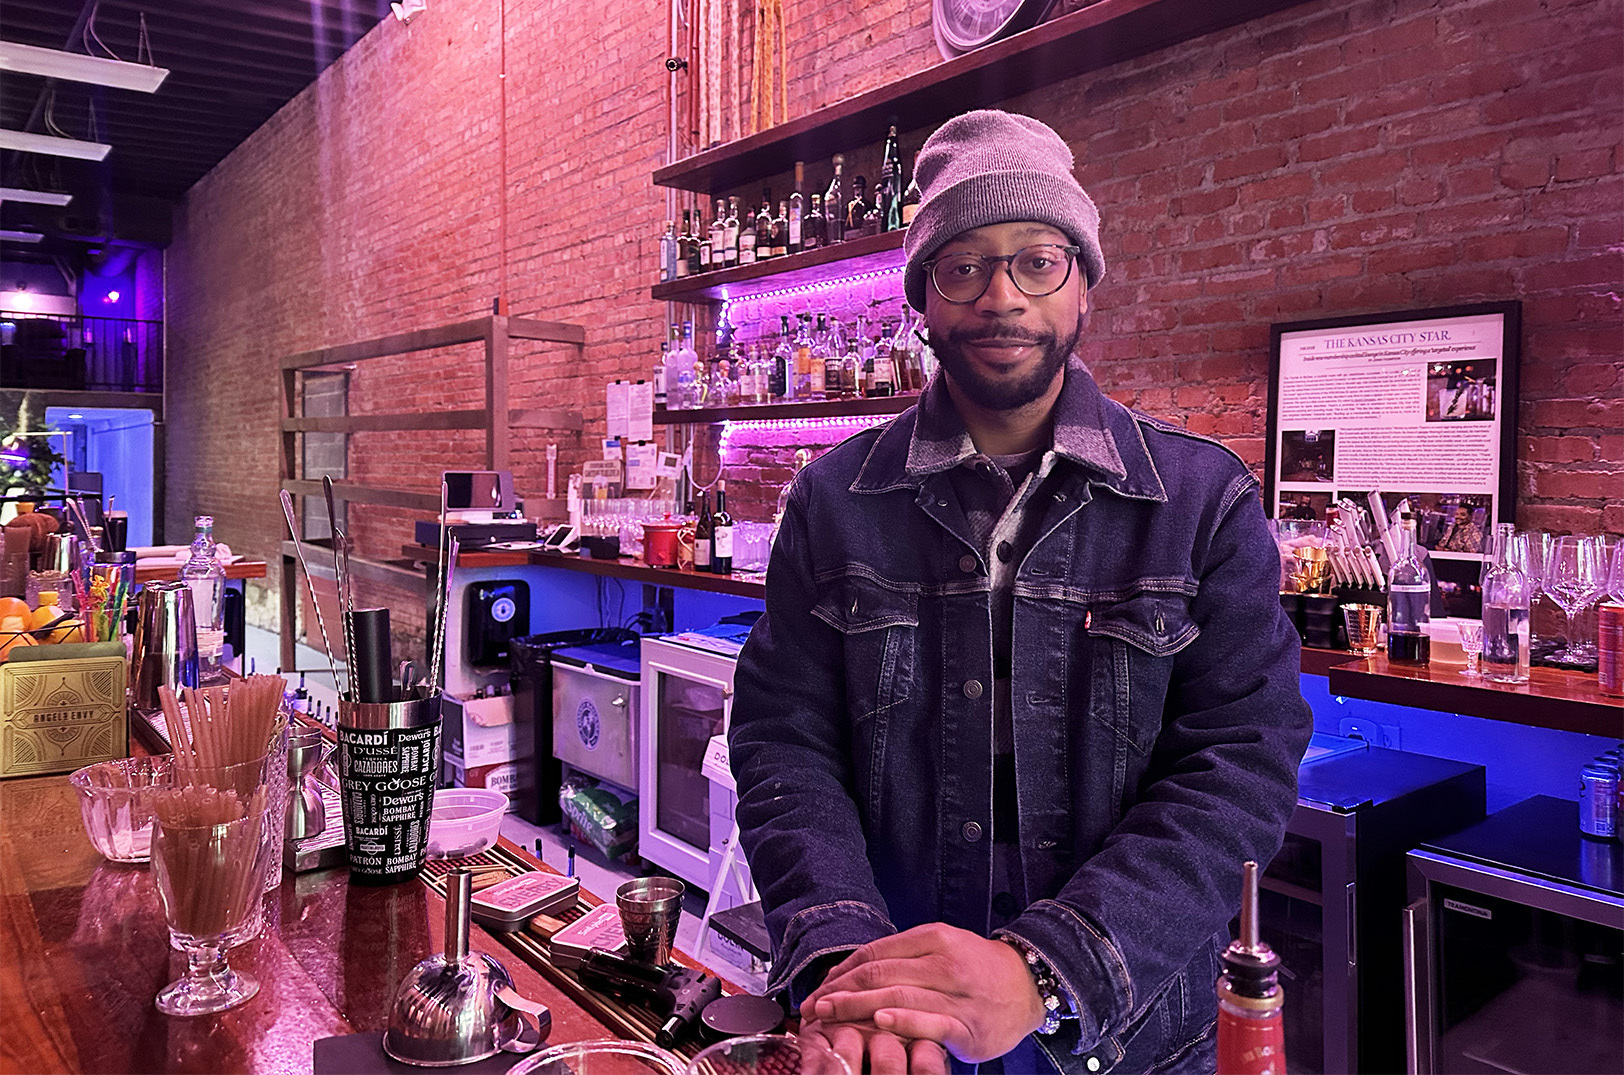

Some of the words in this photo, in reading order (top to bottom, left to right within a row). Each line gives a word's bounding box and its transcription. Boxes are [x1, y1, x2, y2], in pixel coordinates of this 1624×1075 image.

[1324, 339, 1345, 349] THE
[1347, 335, 1388, 348] KANSAS
[1389, 333, 1416, 345] CITY
[71, 710, 94, 720] ENVY
[340, 730, 389, 746] BACARDÍ
[421, 739, 431, 773] BACARDÍ
[354, 760, 398, 774] CAZADORES
[341, 778, 371, 792] GREY
[375, 776, 427, 792] GOOSE
[383, 804, 417, 816] BOMBAY
[382, 811, 417, 823] SAPPHIRE
[567, 800, 593, 834] Sprite
[355, 825, 389, 836] BACARDÍ
[350, 854, 382, 866] PATRÓN
[386, 853, 418, 866] BOMBAY
[385, 861, 417, 874] SAPPHIRE
